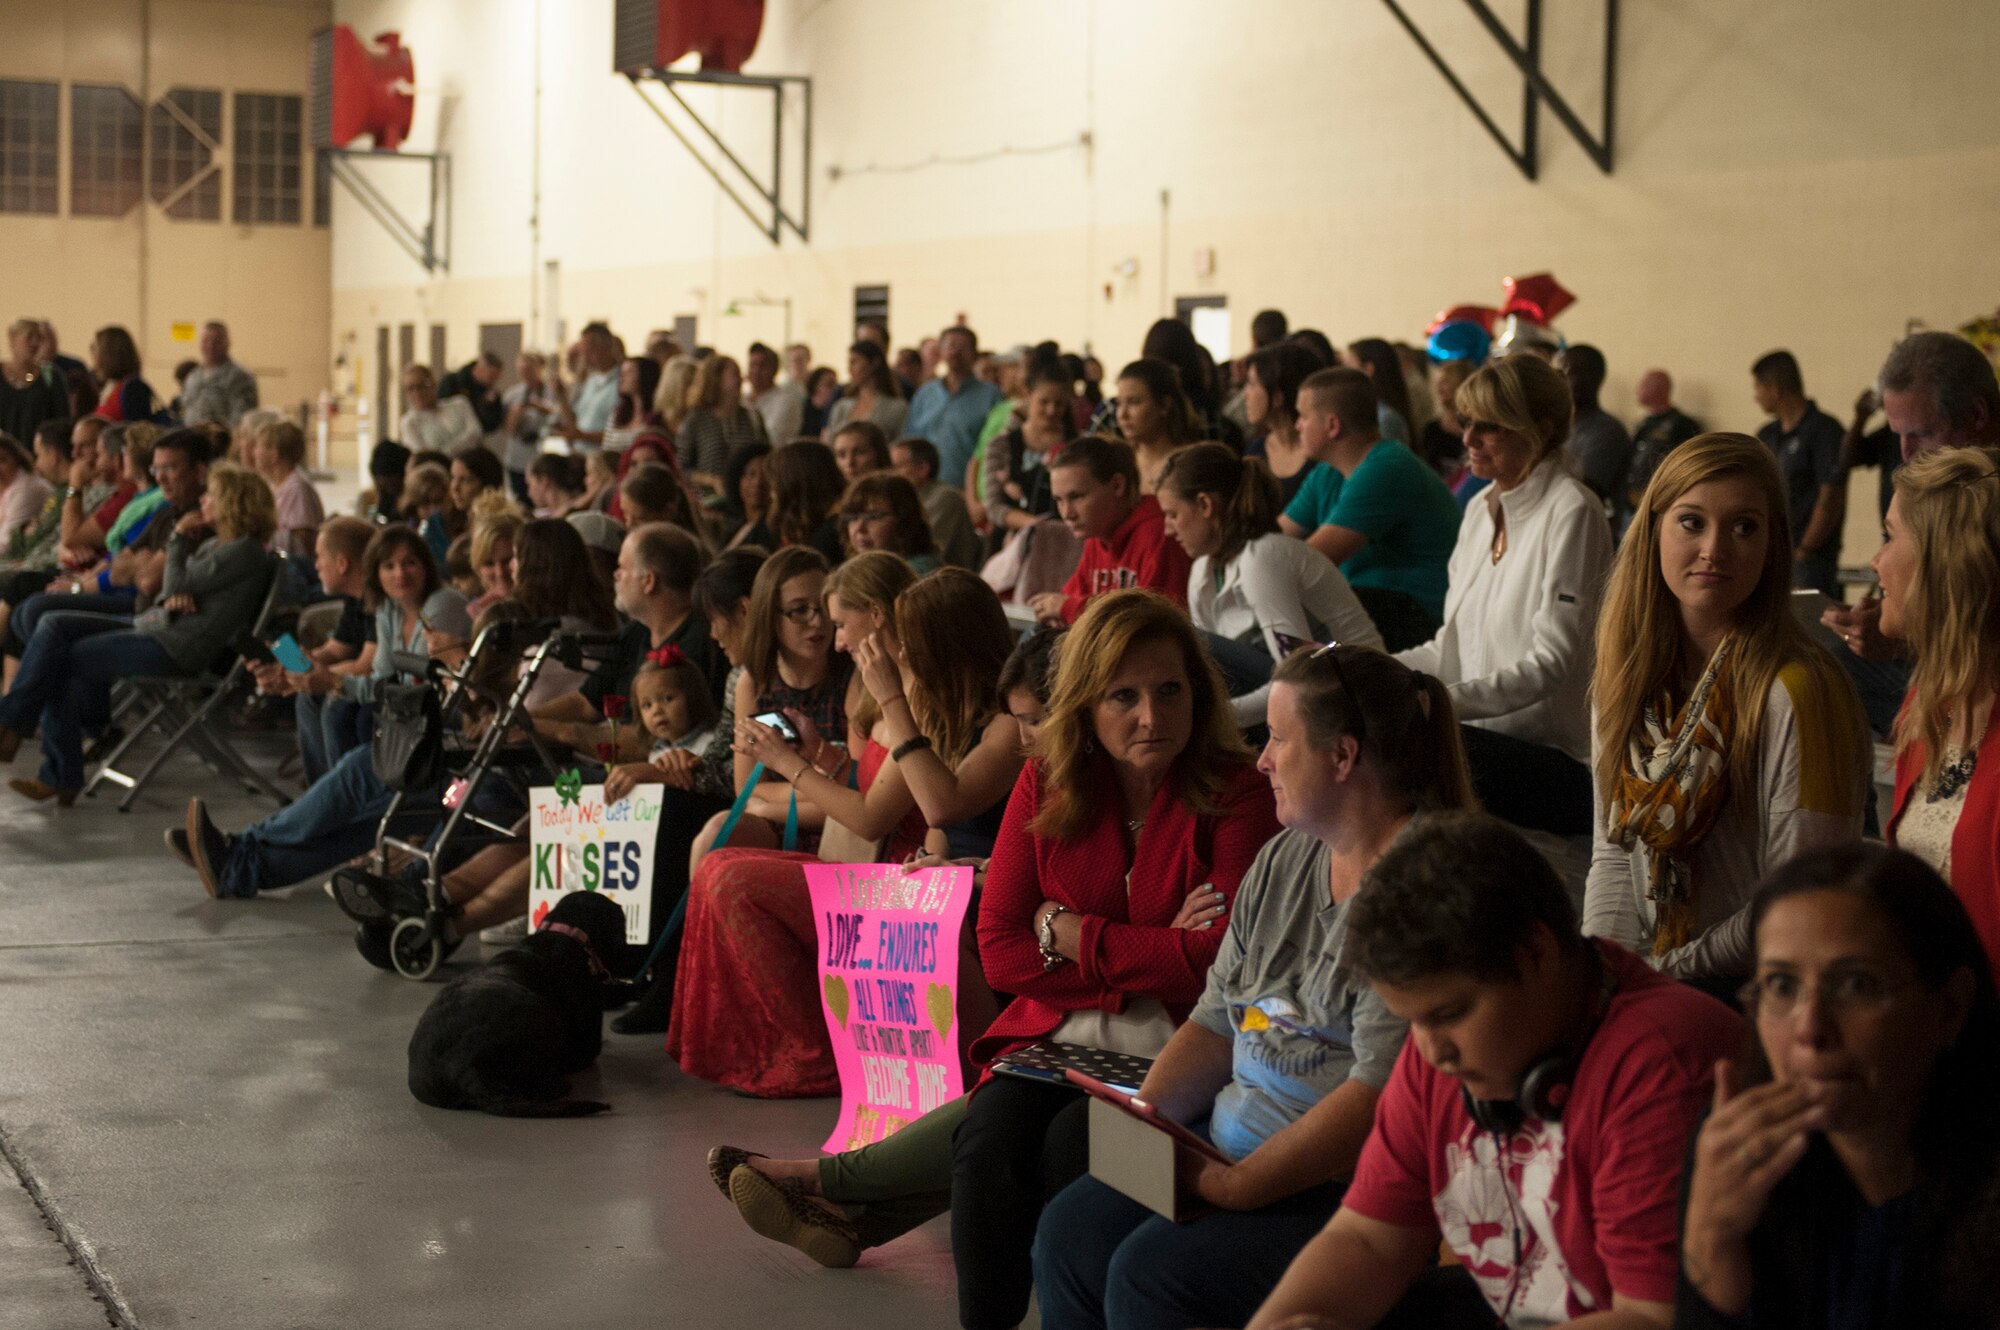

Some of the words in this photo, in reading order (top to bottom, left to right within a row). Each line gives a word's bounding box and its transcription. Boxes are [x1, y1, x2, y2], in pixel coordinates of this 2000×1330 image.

[537, 800, 572, 835] Today
[577, 801, 602, 824] We
[634, 798, 660, 821] Our
[535, 841, 641, 892] KISSES
[877, 920, 938, 973] ENDURES
[854, 979, 876, 1021] ALL
[877, 979, 918, 1026] THINGS
[860, 1055, 912, 1109] WELCOME
[915, 1061, 948, 1114] HOME
